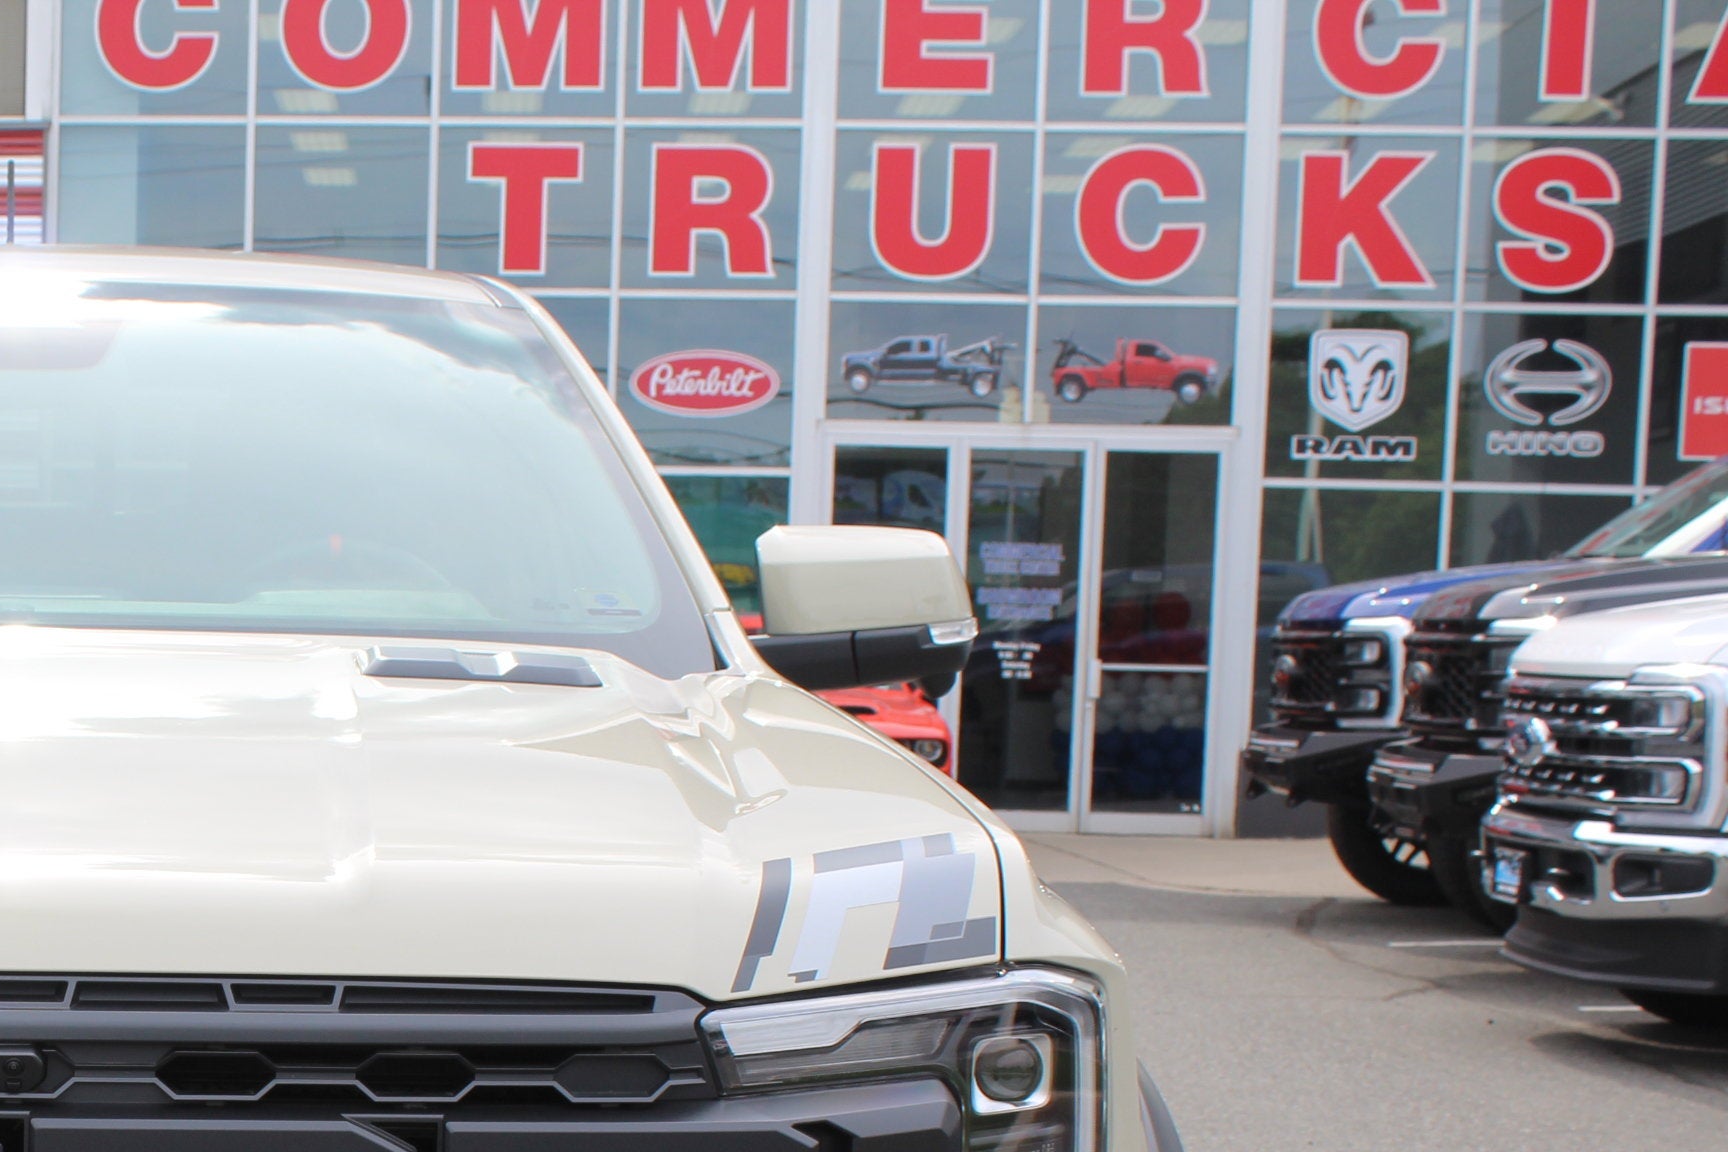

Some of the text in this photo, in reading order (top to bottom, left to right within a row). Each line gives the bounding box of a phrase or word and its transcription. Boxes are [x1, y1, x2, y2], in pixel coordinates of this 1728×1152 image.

[95, 0, 1728, 104] COMMERCI
[466, 141, 1622, 293] TRUCKS
[649, 362, 766, 398] Peterbilt
[1290, 434, 1418, 461] RAM
[1485, 429, 1606, 458] HINO
